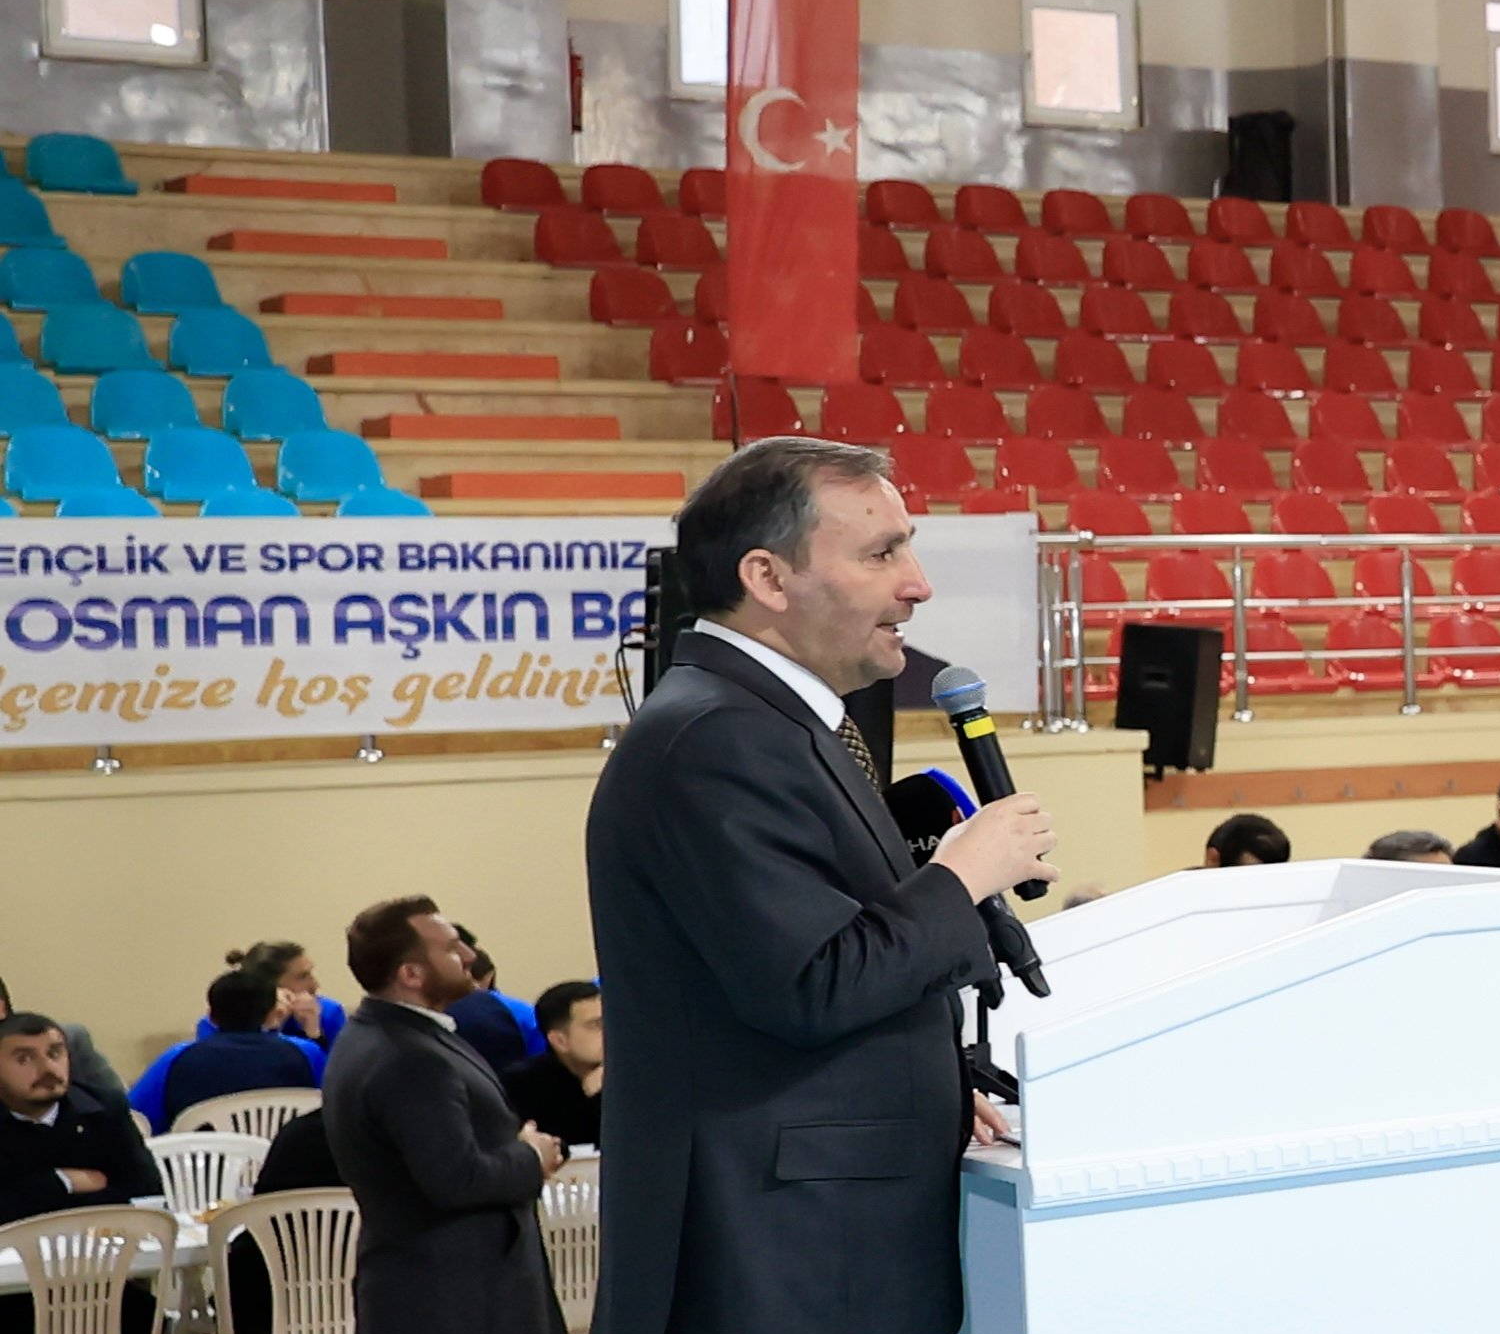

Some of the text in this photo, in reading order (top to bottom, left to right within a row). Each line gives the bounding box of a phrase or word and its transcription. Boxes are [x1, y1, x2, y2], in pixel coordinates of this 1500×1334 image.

[0, 532, 647, 586] ENÇLİK VE SPOR BAKANIMIZ
[5, 589, 648, 661] OSMAN AŞKIN BA
[0, 651, 634, 733] çemize hoş geldiniz
